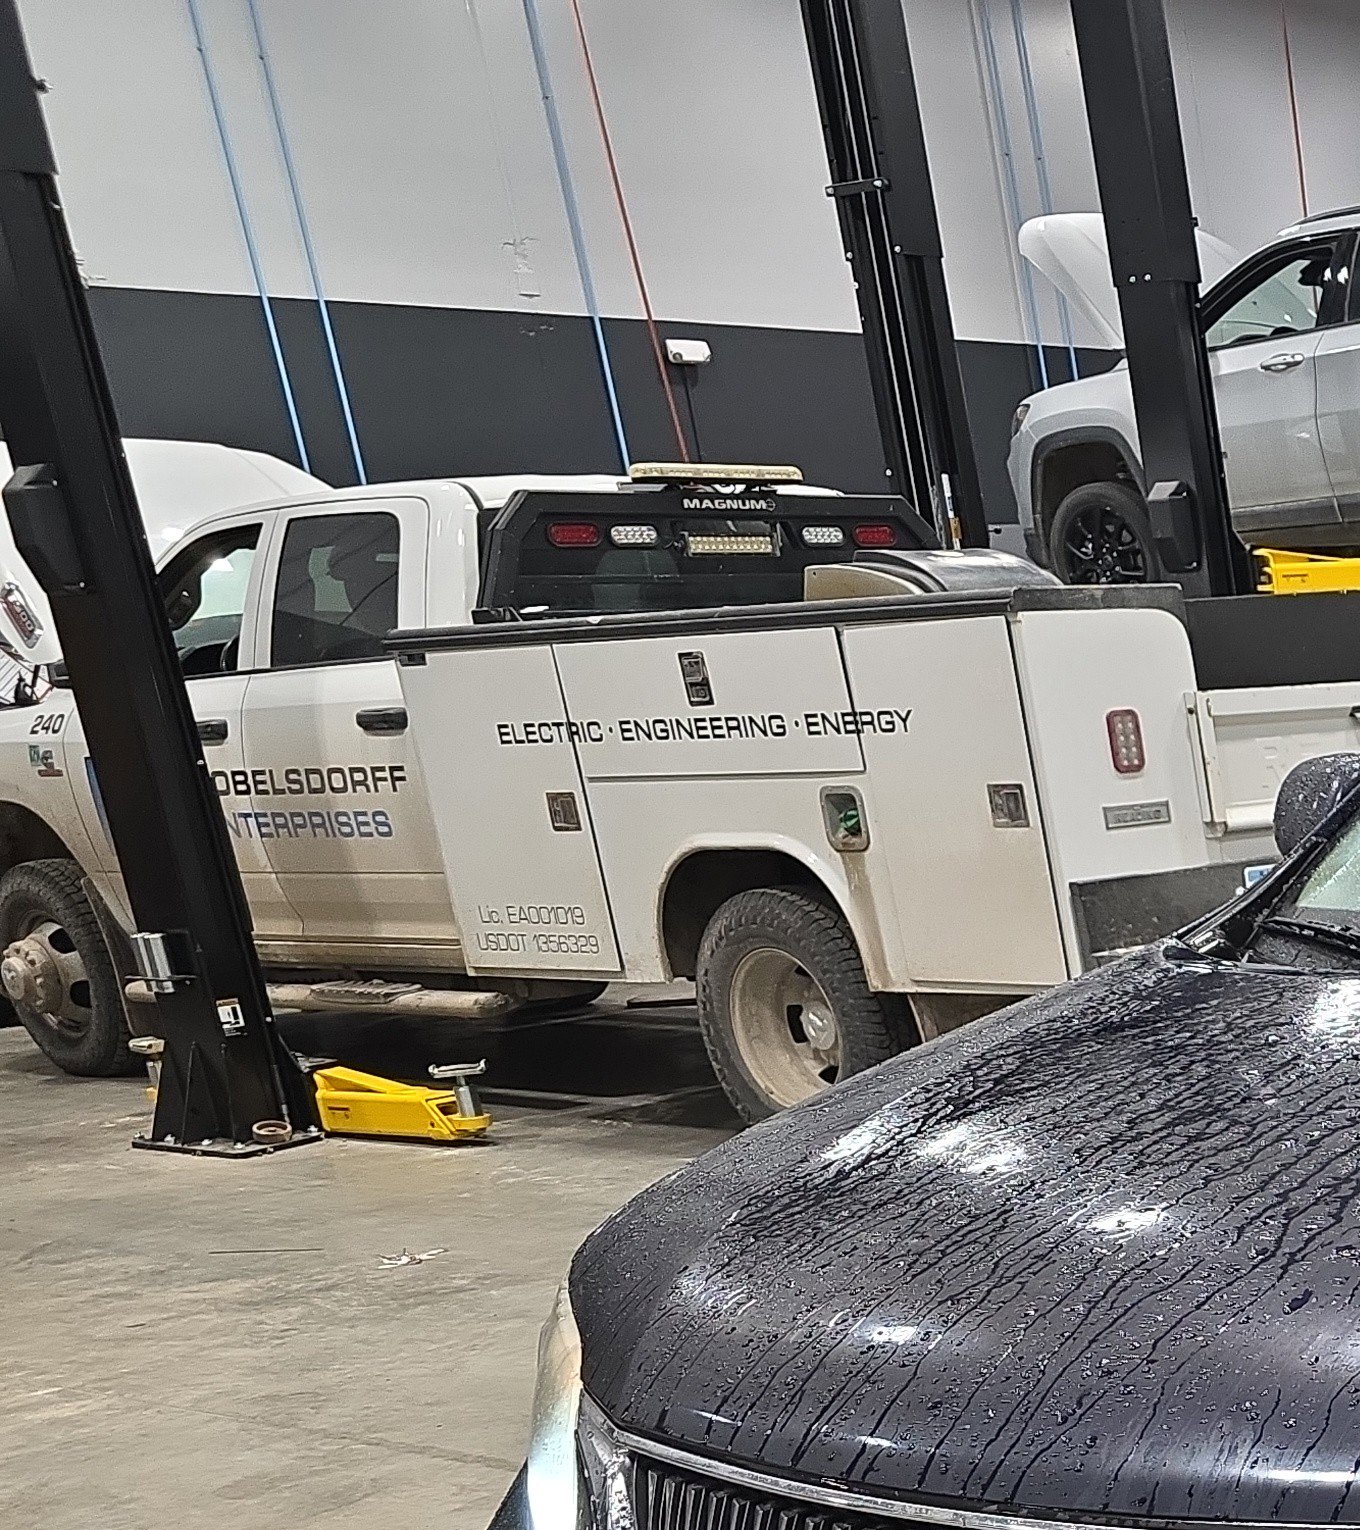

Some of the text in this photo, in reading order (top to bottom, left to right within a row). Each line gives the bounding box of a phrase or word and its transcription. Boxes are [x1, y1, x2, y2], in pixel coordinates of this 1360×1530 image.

[683, 498, 767, 510] MAGNUM
[29, 713, 65, 735] 240
[497, 709, 913, 745] ELECTRIC ENGINEERING ENERGY
[211, 765, 407, 797] OBELSDORFF
[226, 810, 394, 839] NTERPRISES
[478, 905, 586, 925] Lic. EA001019
[476, 932, 600, 954] USDOT 1356329
